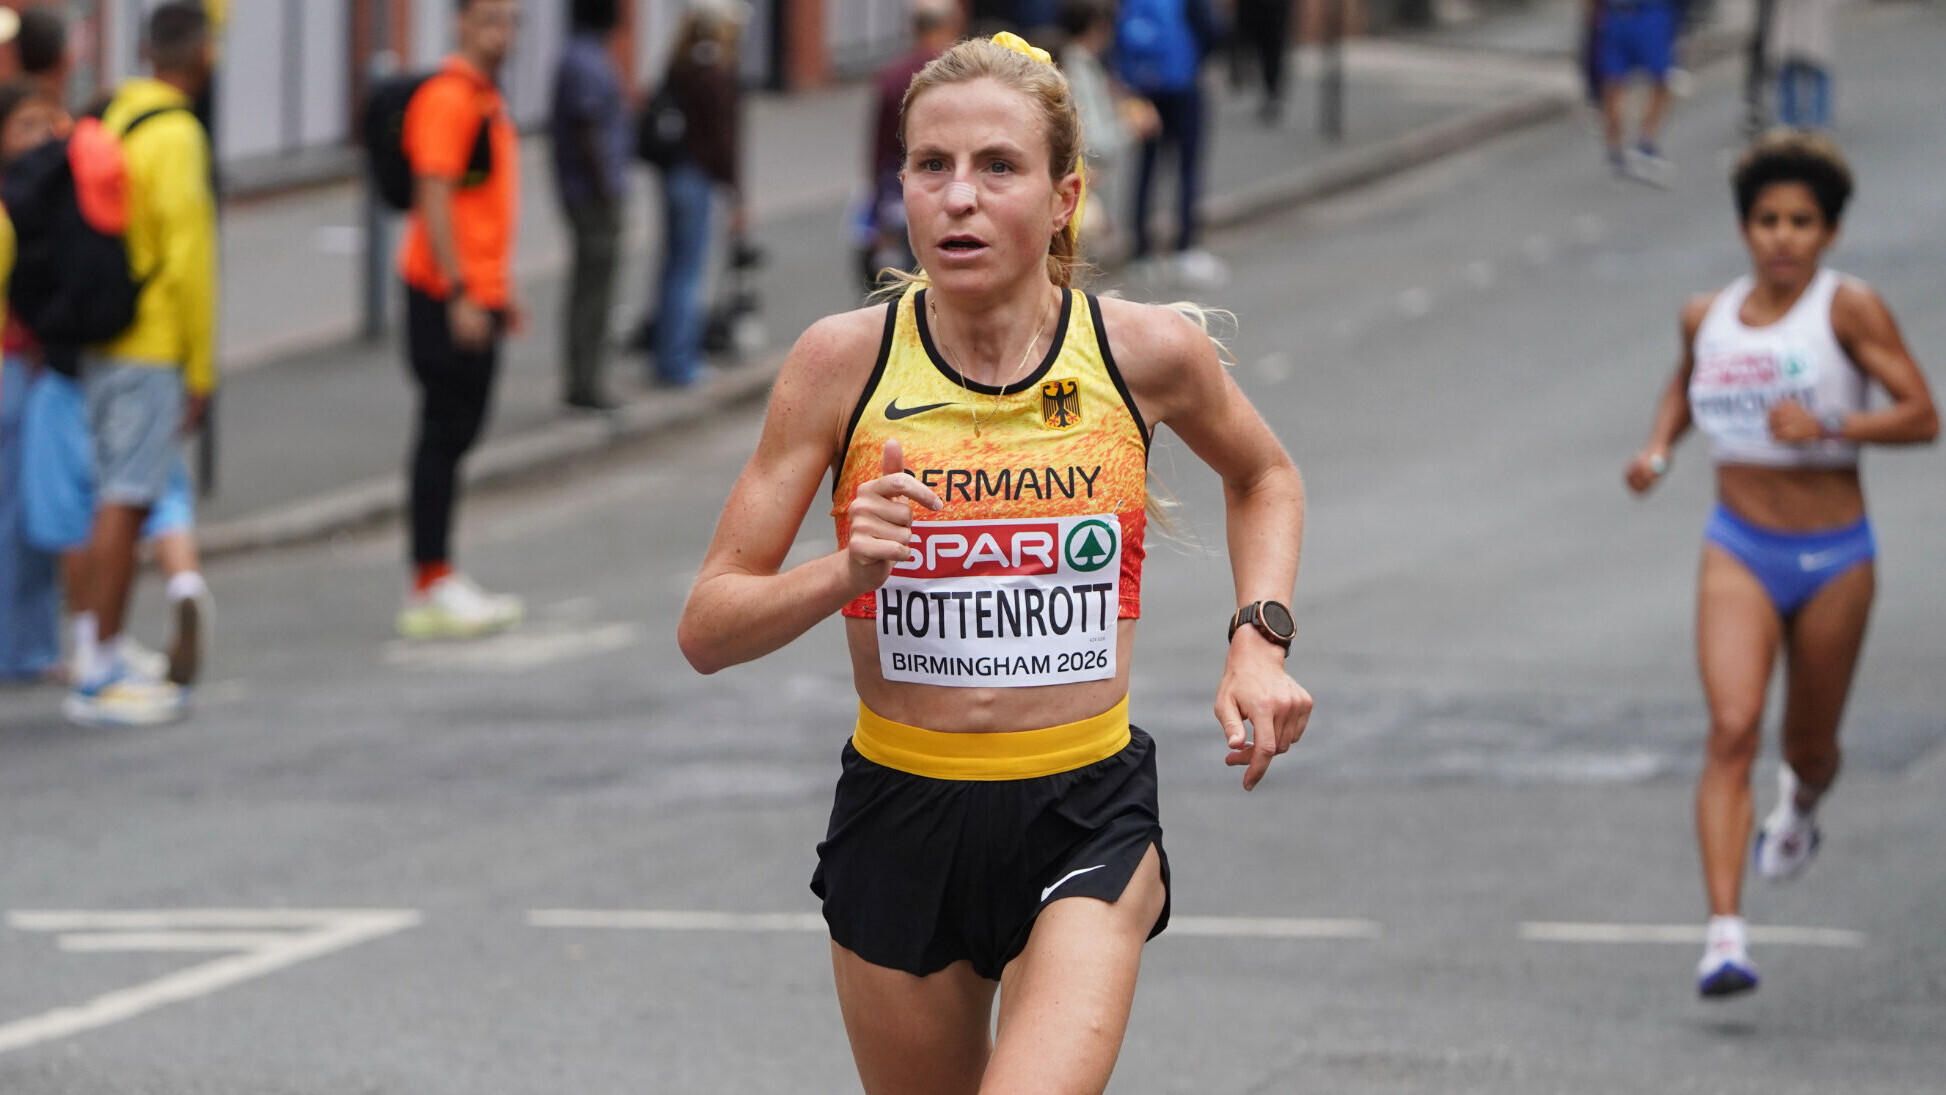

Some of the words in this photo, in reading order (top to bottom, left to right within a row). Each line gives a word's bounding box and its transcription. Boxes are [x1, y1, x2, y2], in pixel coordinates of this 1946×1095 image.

[904, 466, 1101, 501] ERMANY
[893, 531, 1054, 571] SPAR
[881, 582, 1113, 639] HOTTENROTT
[892, 651, 1050, 676] BIRMINGHAM
[1057, 649, 1108, 673] 2026
